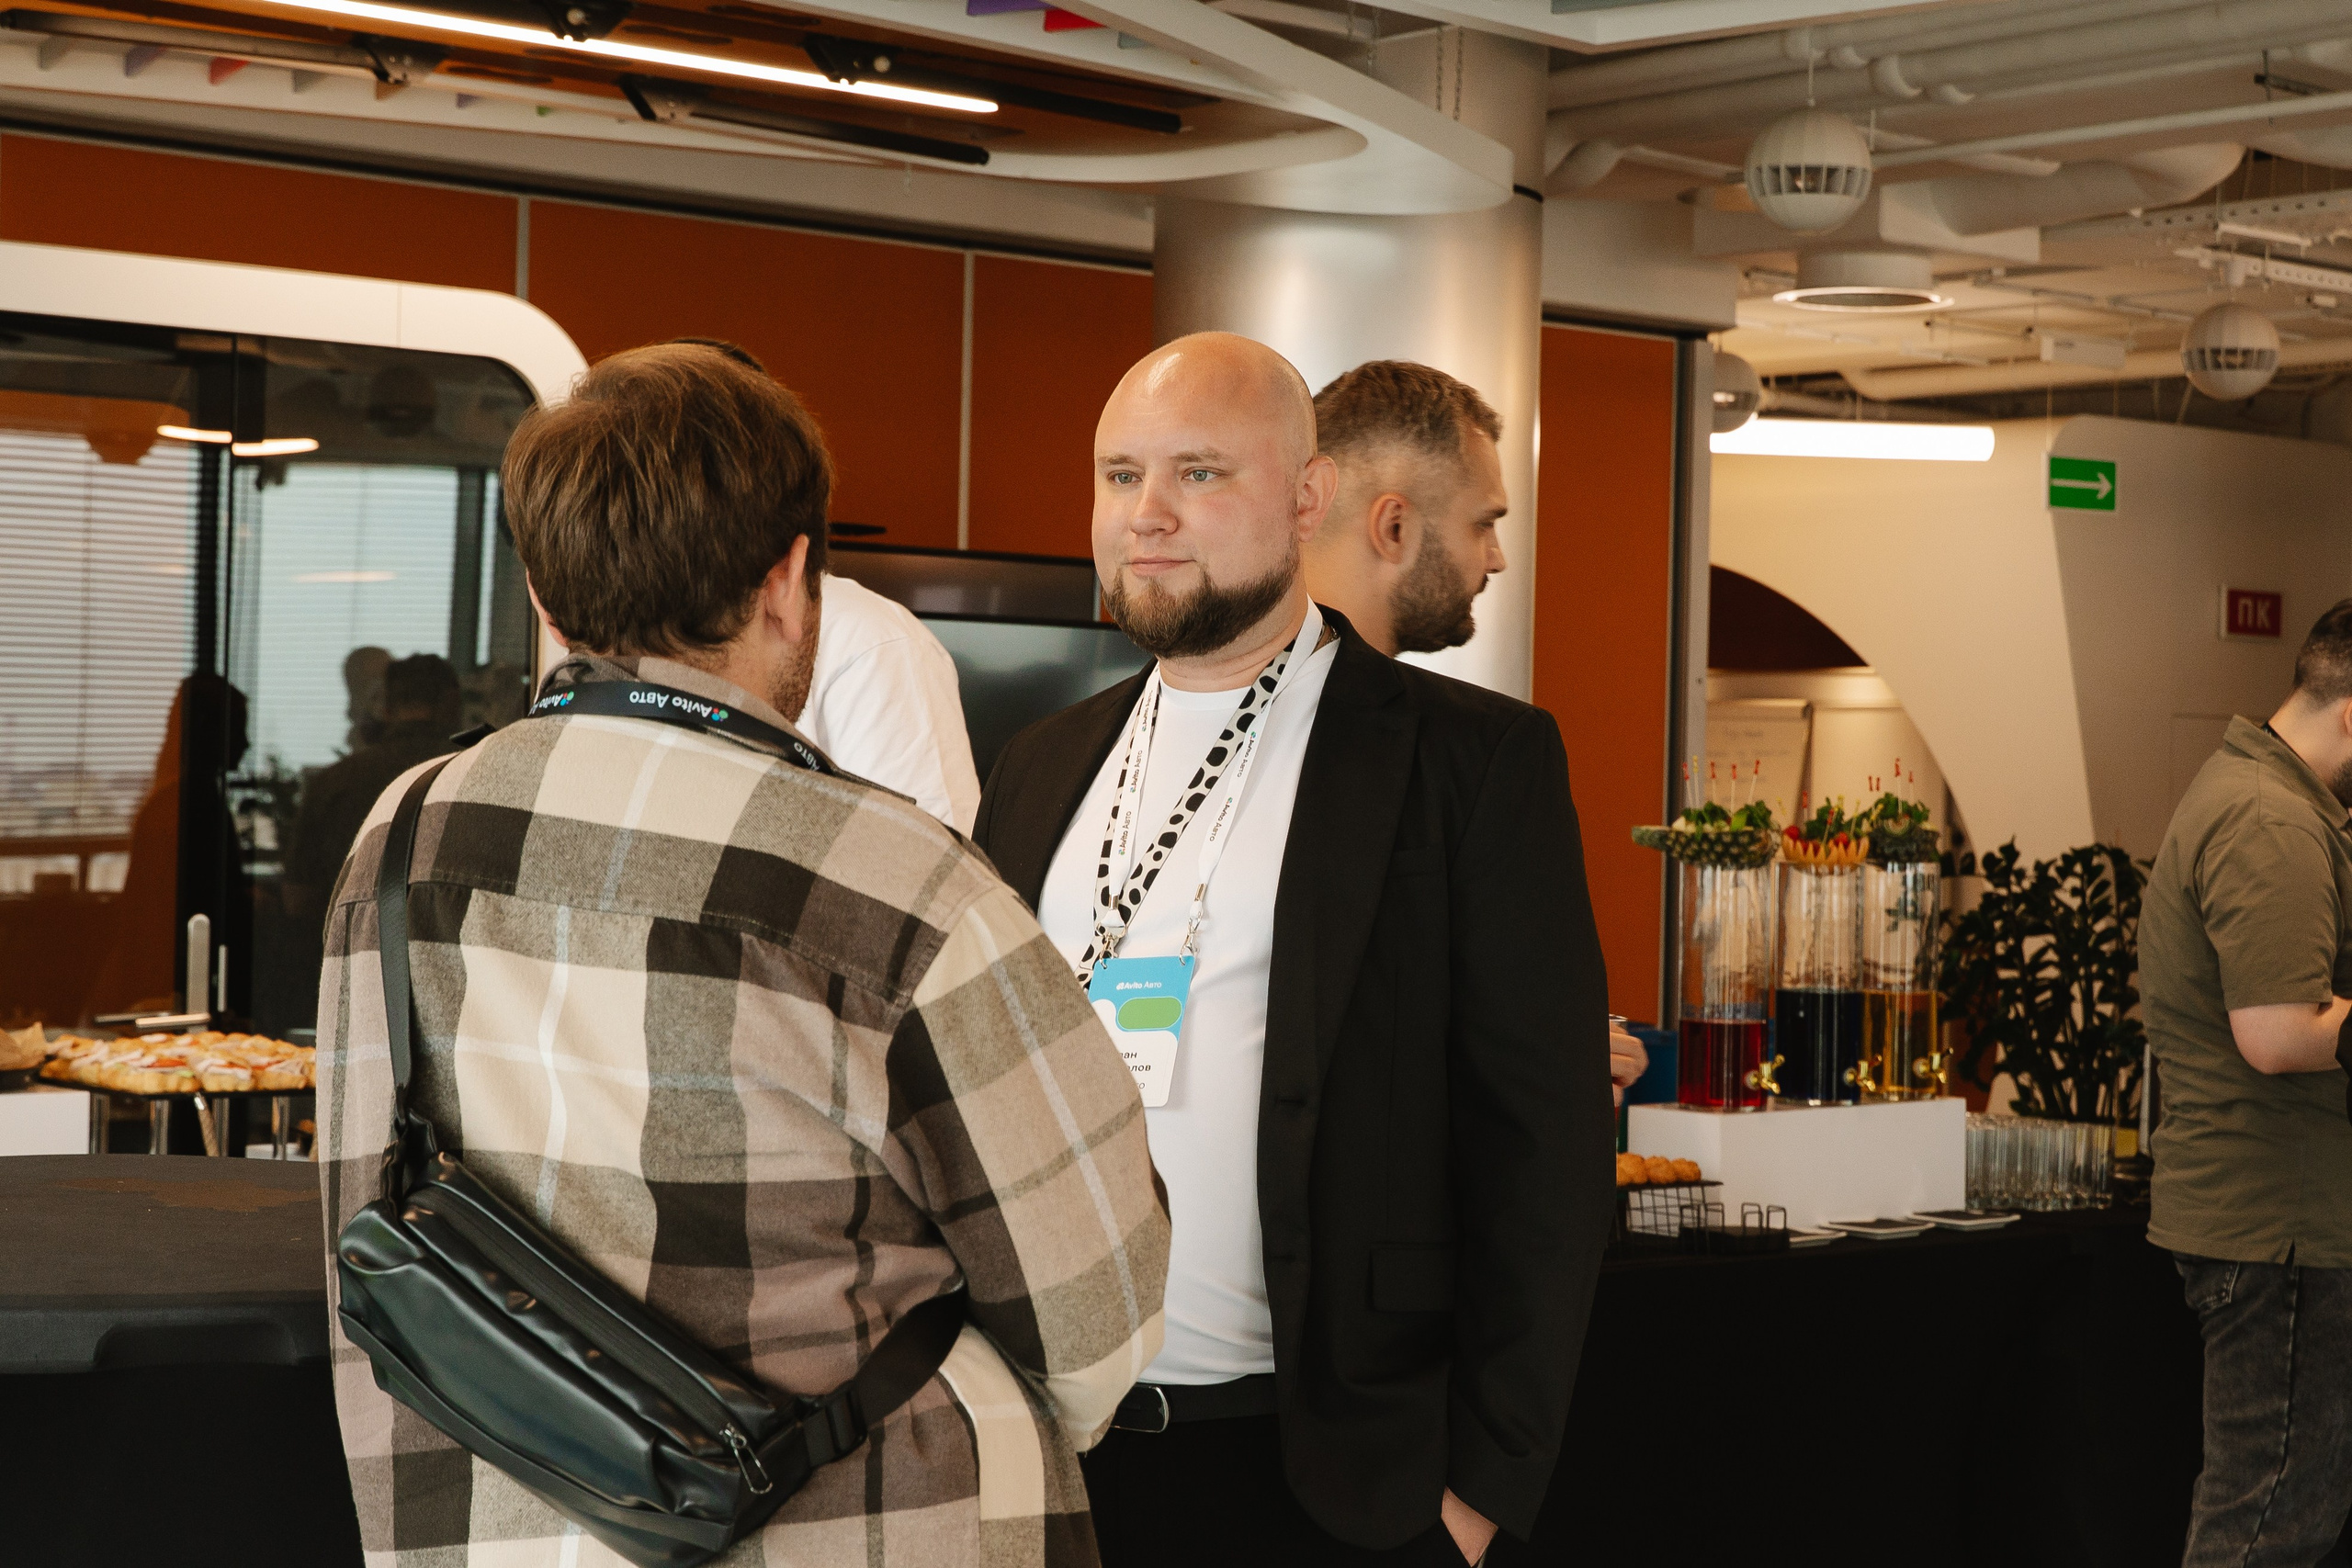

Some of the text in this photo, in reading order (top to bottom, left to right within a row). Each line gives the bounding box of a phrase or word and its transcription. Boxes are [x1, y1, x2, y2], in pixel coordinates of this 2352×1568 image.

[2238, 596, 2270, 628] ПК
[672, 696, 712, 717] Avito
[1245, 739, 1254, 757] Avito
[1131, 769, 1139, 785] Avito
[1218, 804, 1229, 820] Avito
[1120, 830, 1128, 848] Avito
[1124, 980, 1143, 989] Avito
